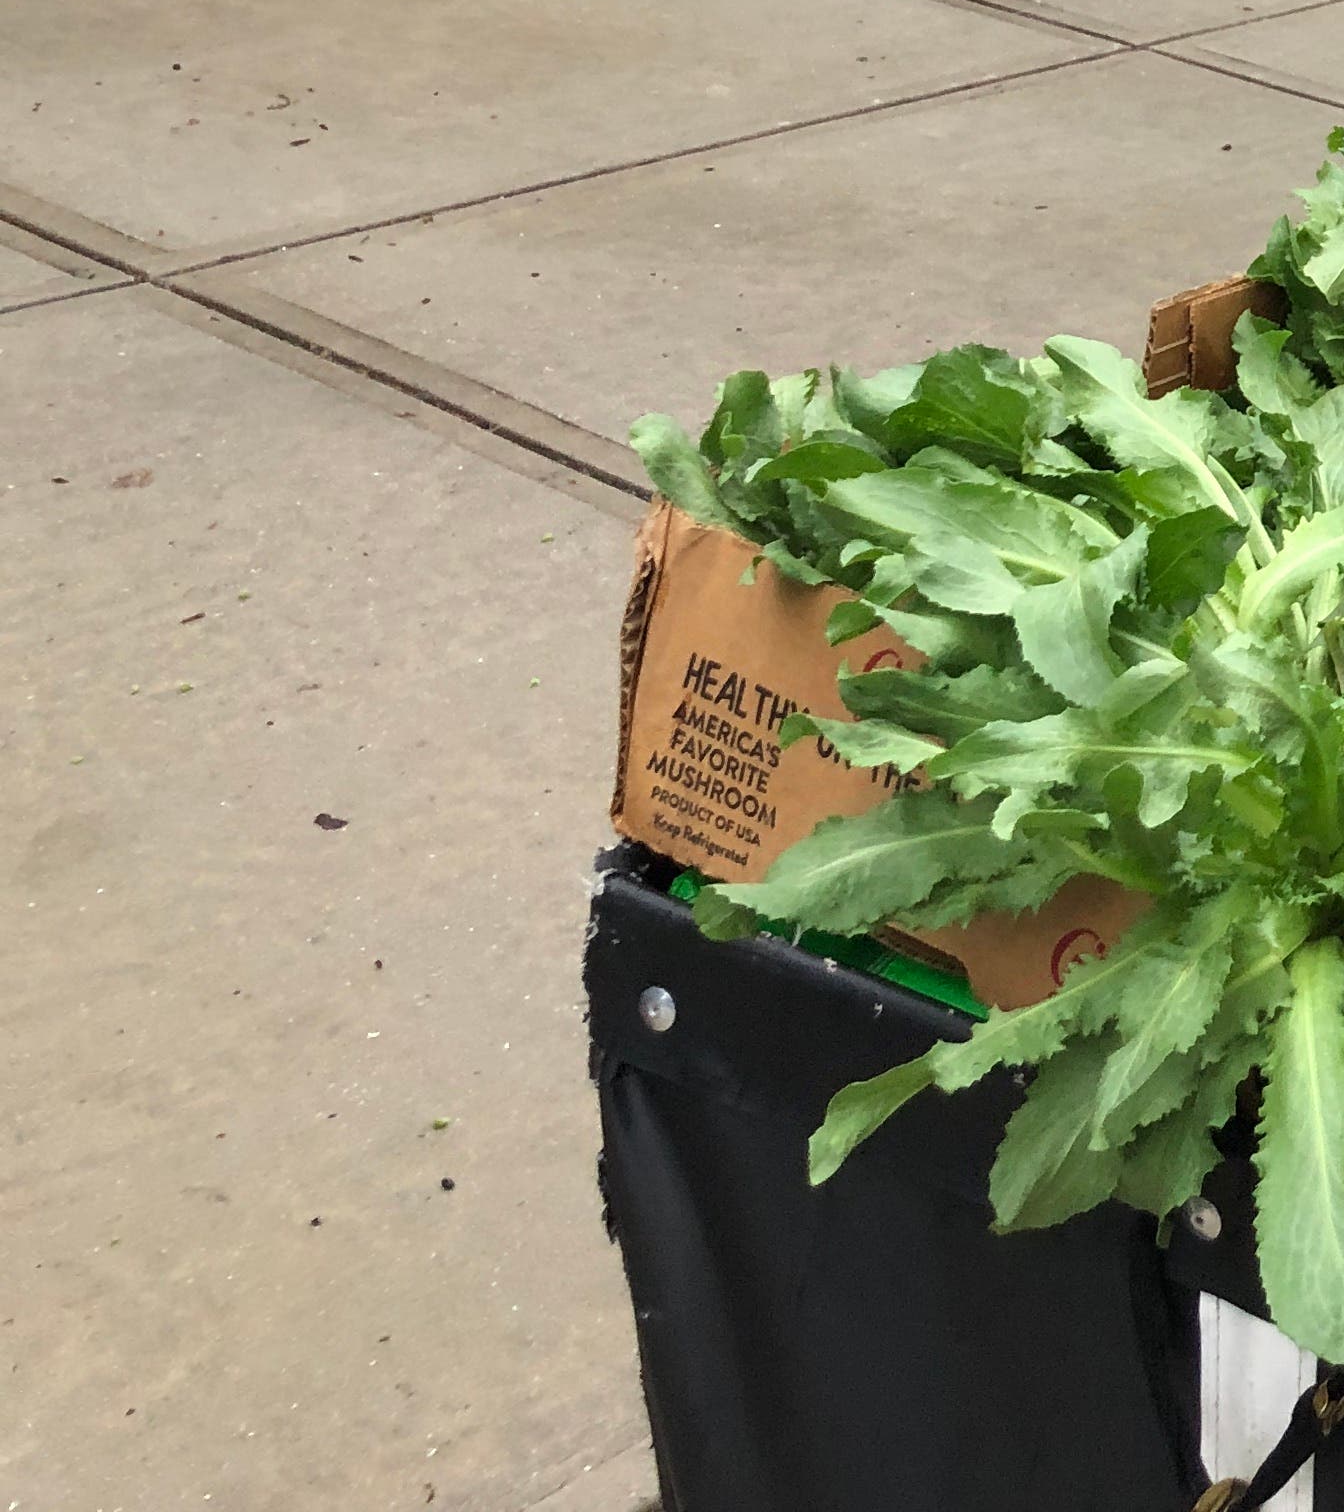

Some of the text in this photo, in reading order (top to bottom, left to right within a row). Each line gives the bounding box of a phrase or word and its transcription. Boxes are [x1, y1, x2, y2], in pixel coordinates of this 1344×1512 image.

[670, 728, 771, 795] FAVORITE
[672, 700, 783, 769] AMERICA'S
[645, 750, 778, 831] MUSHROOM
[650, 784, 762, 848] PRODUCT OF USA
[683, 824, 750, 867] Refrigerated
